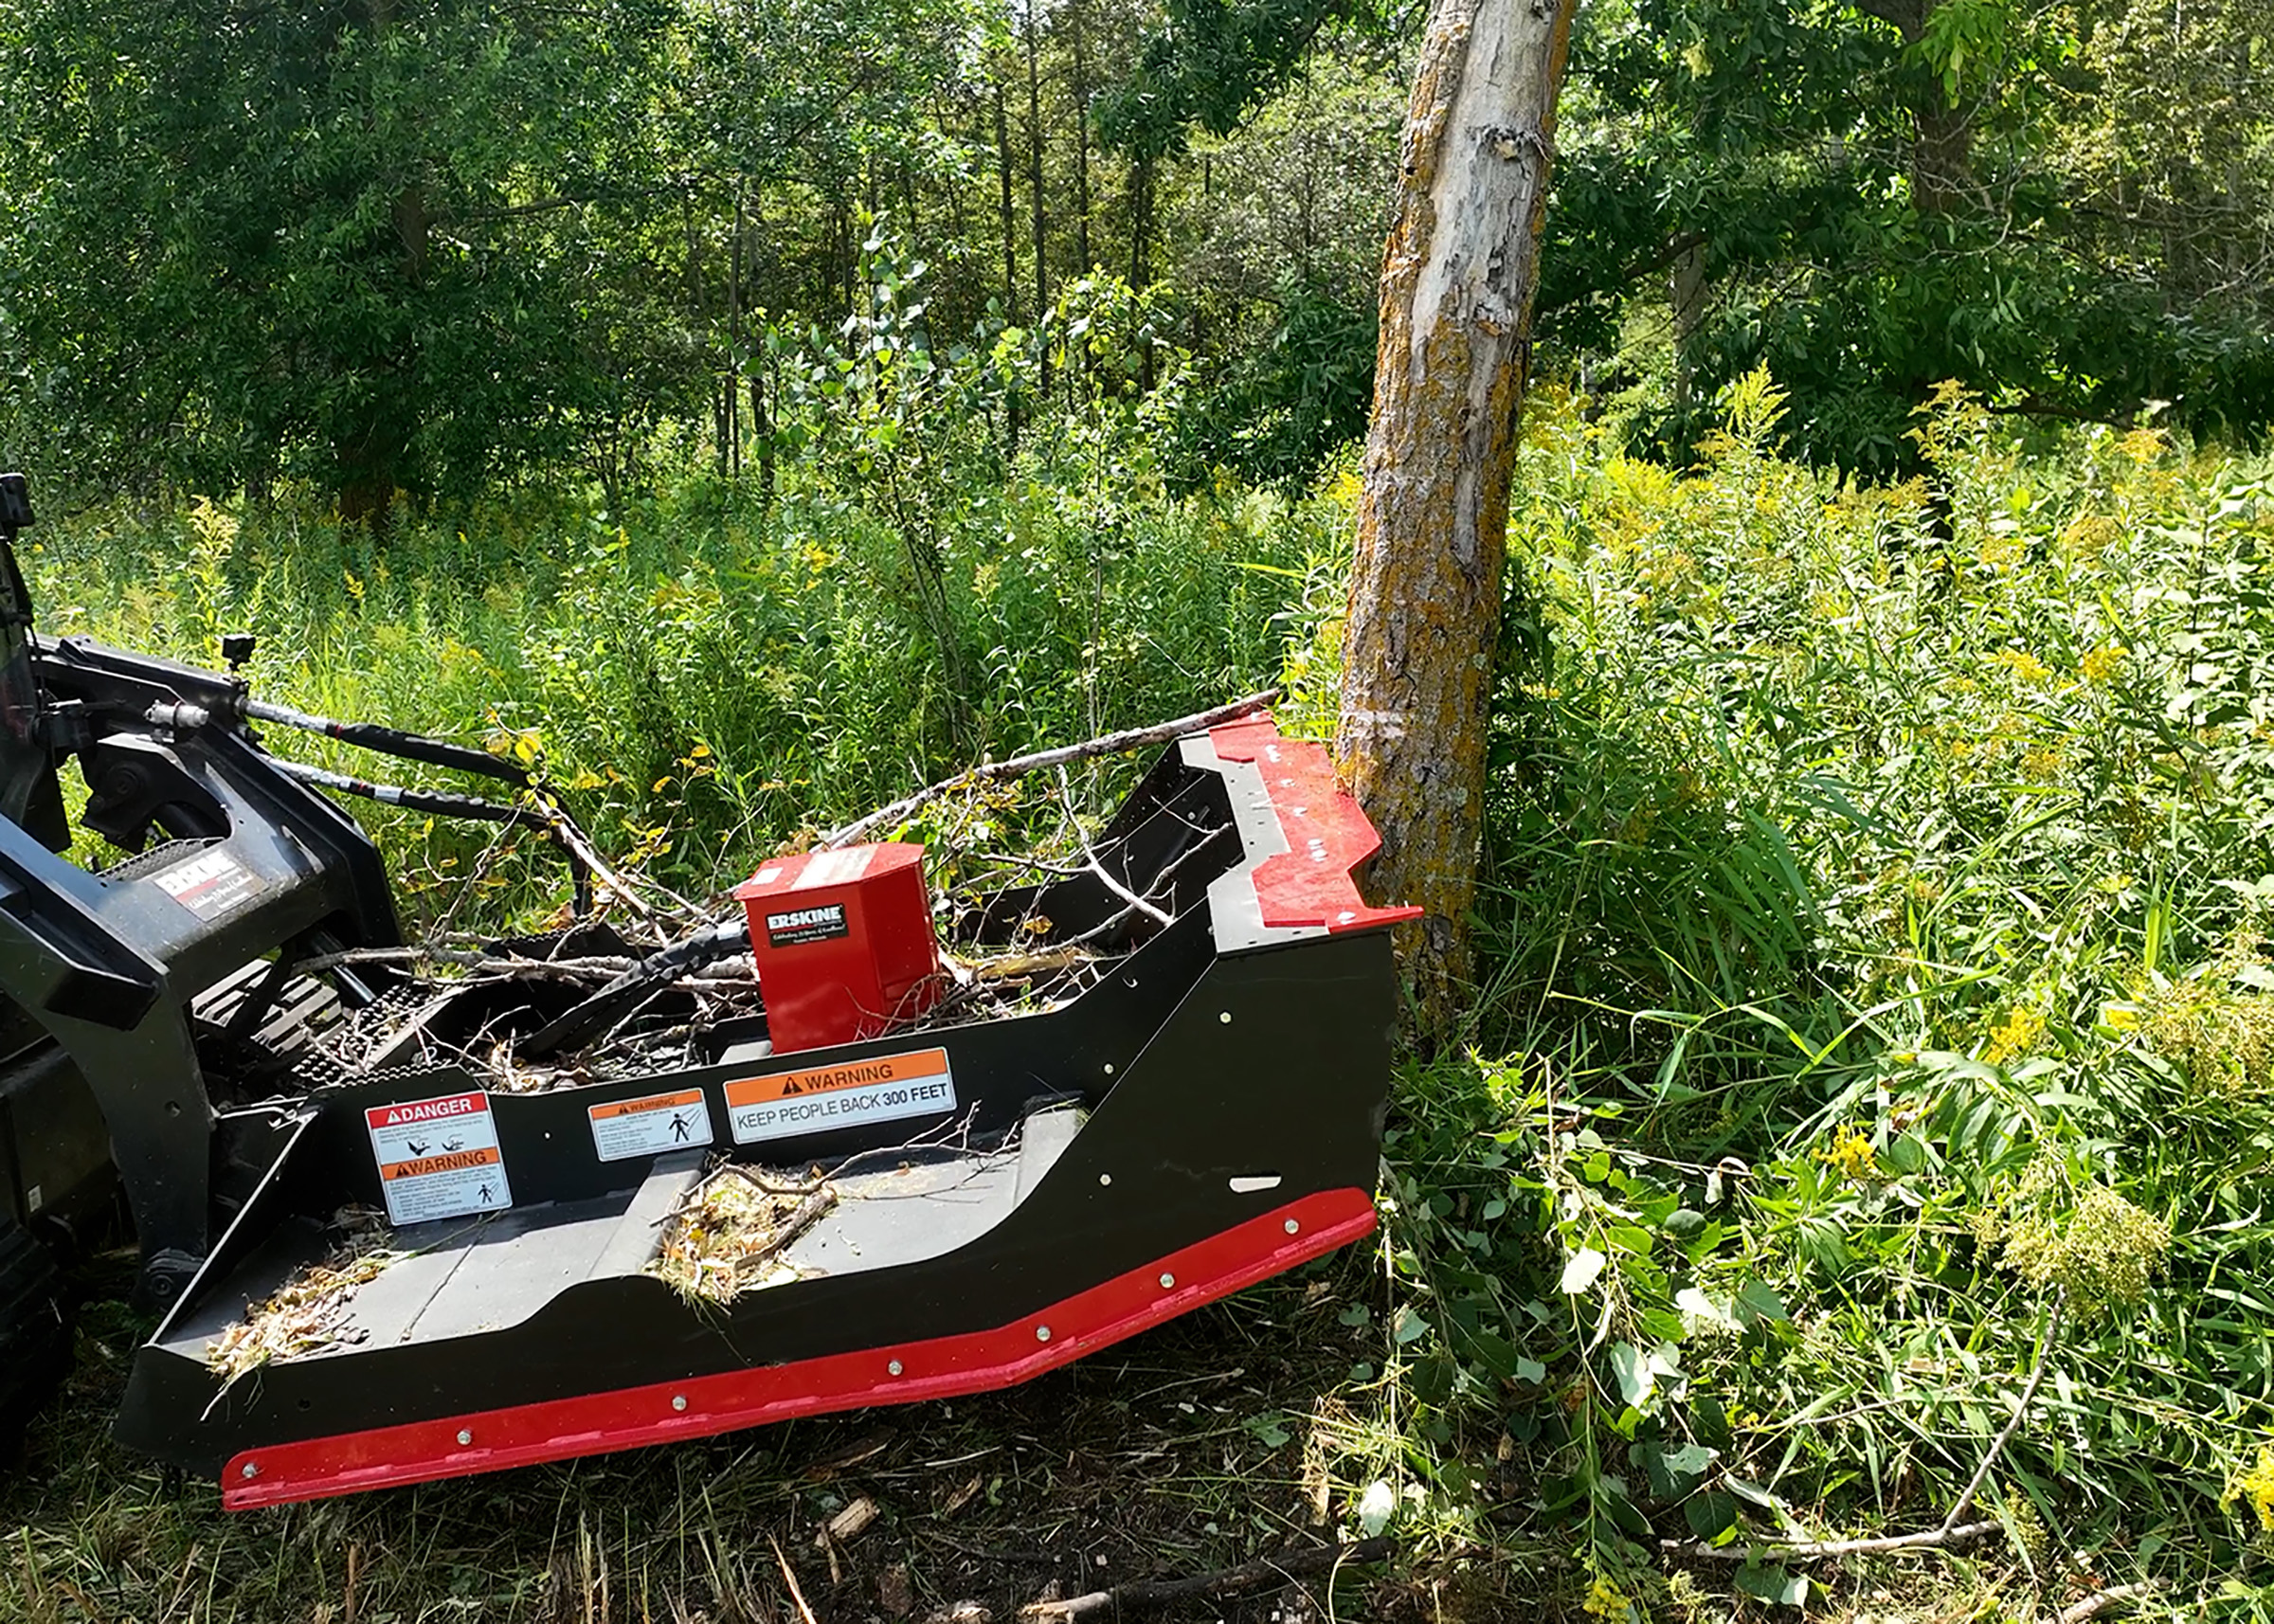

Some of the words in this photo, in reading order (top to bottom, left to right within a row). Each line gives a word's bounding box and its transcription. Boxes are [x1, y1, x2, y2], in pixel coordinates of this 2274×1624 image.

[767, 907, 841, 929] ERSKINE
[804, 1064, 893, 1090] WARNING
[401, 1098, 472, 1122] DANGER
[737, 1110, 776, 1129] KEEP
[780, 1101, 839, 1122] PEOPLE
[840, 1093, 881, 1112] BACK
[883, 1090, 908, 1106] 300
[911, 1083, 948, 1102] FEET
[409, 1151, 487, 1175] WARNING
